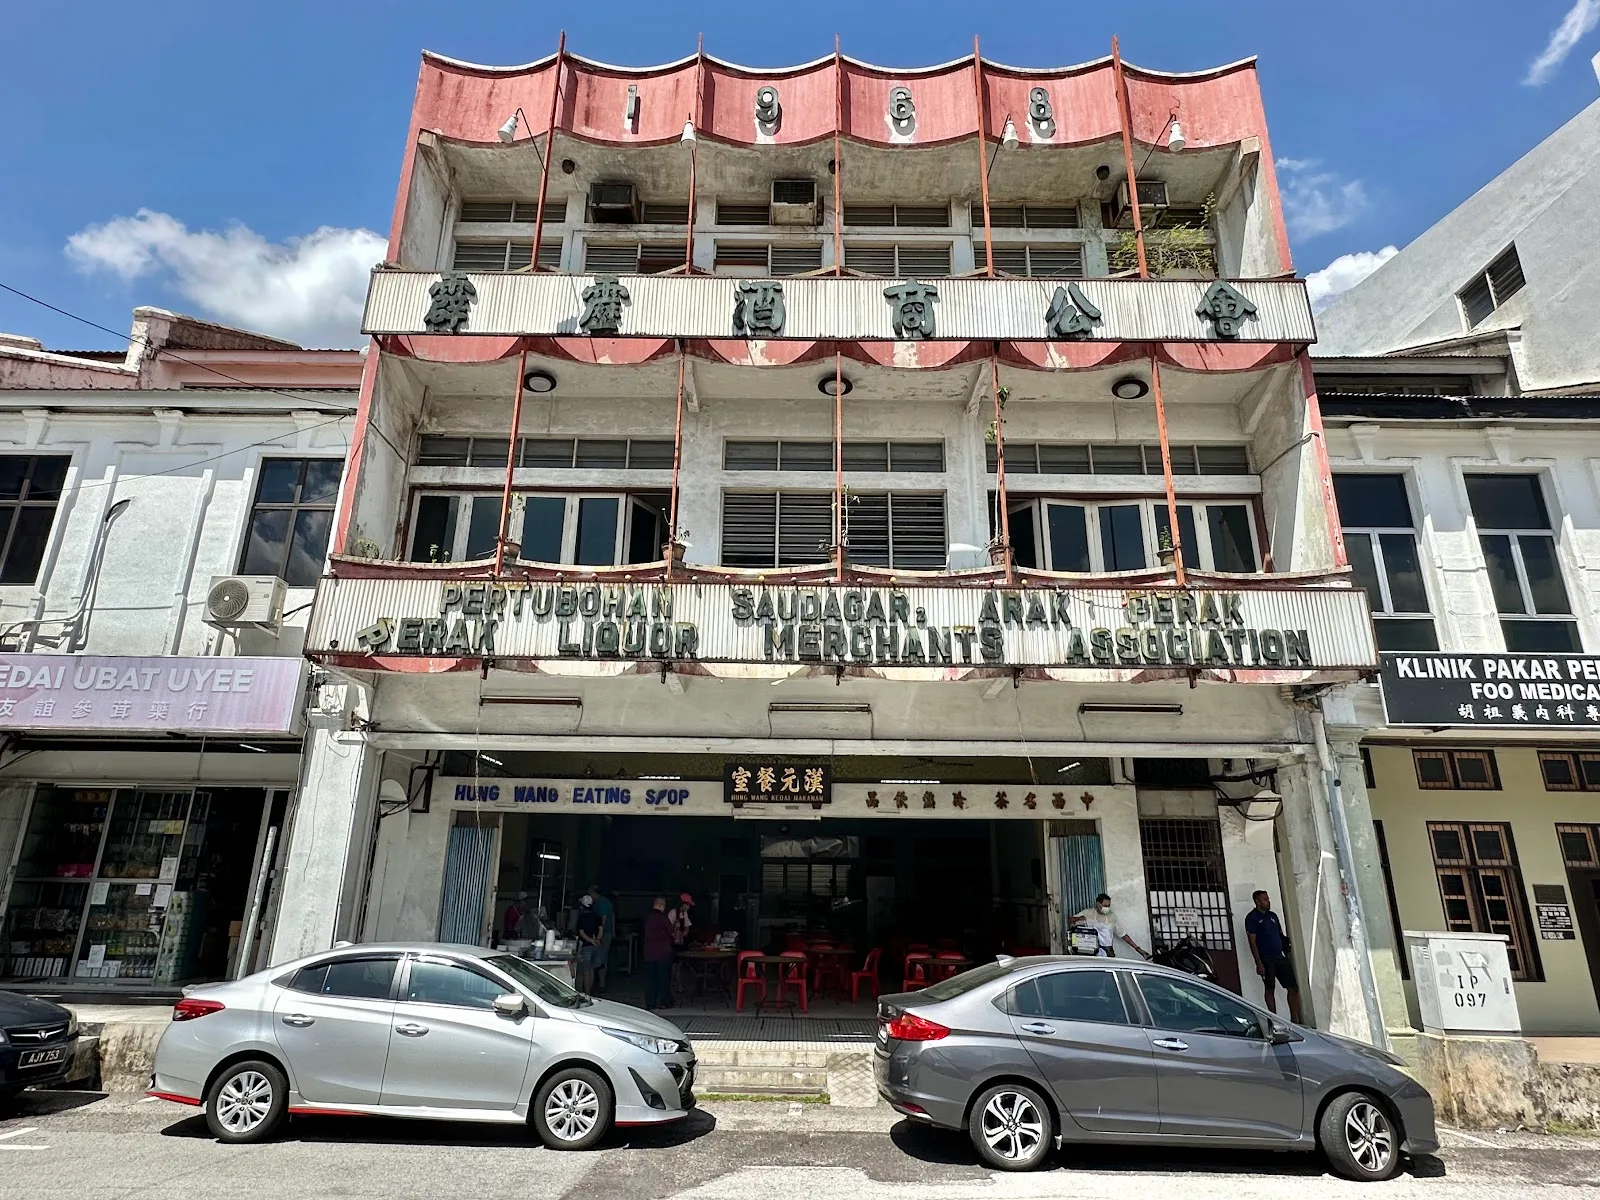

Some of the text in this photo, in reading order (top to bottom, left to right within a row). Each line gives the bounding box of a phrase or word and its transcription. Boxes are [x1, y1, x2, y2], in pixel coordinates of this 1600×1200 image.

[424, 271, 1258, 338] 霹靂酒商公會
[440, 583, 673, 619] PERTUBOHAN
[980, 590, 1071, 624] ARAK
[1127, 590, 1245, 624] PERAK
[356, 617, 1311, 661] PERAK LIQUOR MERCHANTS ASSOCIATION
[73, 665, 161, 691] UBAT
[167, 668, 254, 693] UYEE
[1395, 657, 1477, 679] KLINIK
[1482, 658, 1563, 680] PAKAR
[1470, 682, 1600, 701] FOO MEDICA
[454, 784, 500, 802] HUNG
[513, 785, 559, 804] WANG
[572, 787, 631, 805] EATING
[1454, 992, 1486, 1008] 097
[28, 1049, 60, 1064] AJY 753
